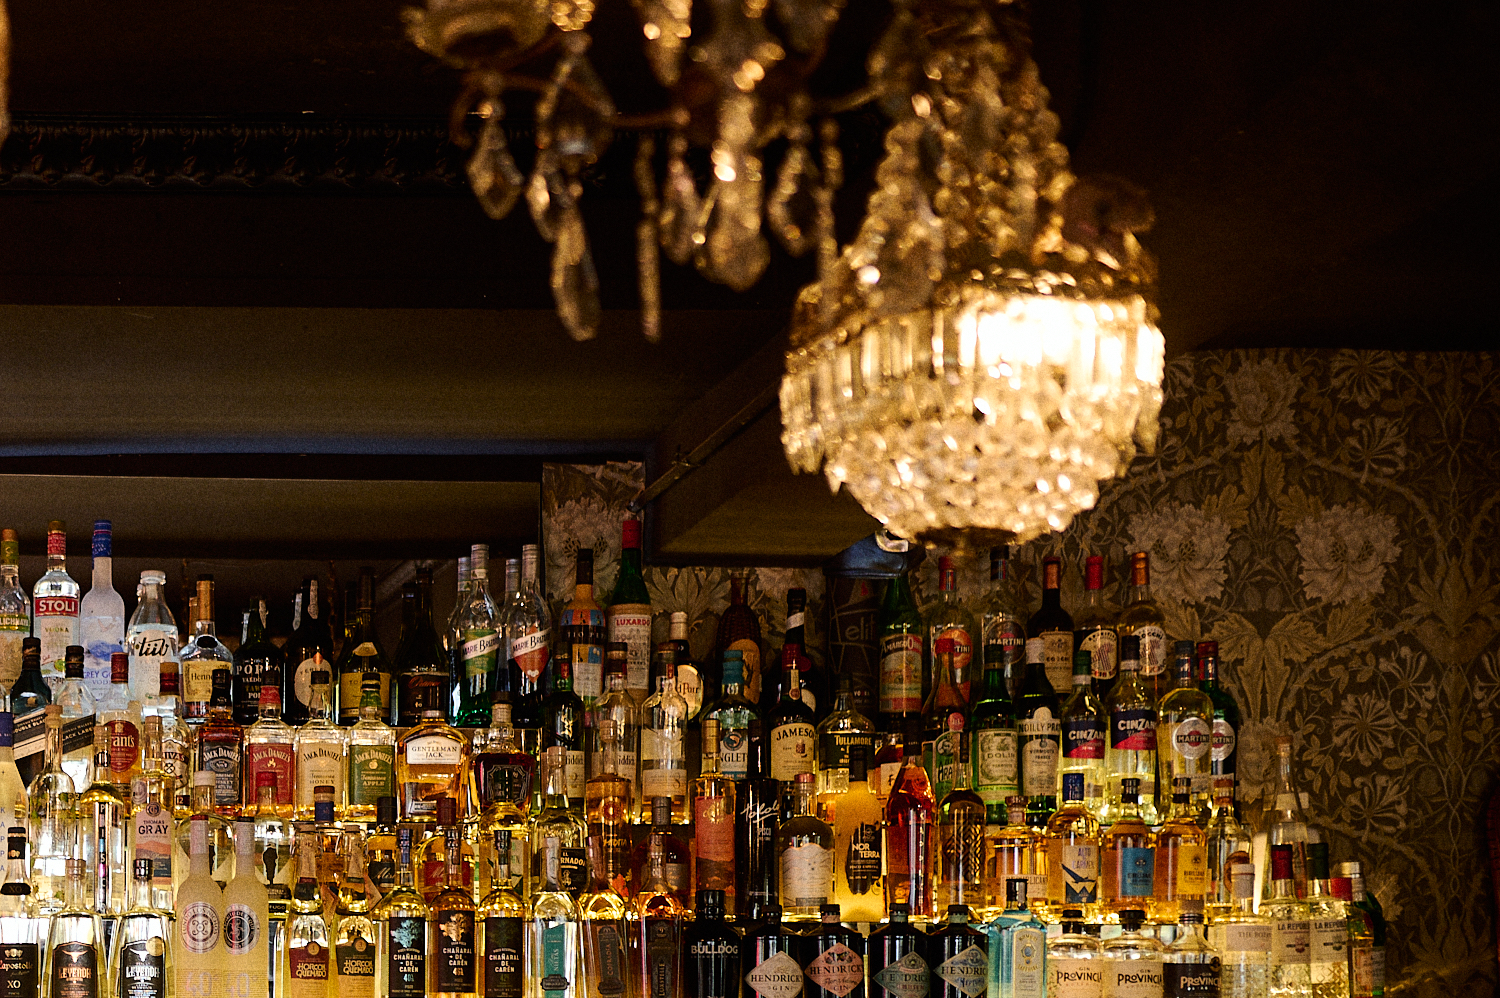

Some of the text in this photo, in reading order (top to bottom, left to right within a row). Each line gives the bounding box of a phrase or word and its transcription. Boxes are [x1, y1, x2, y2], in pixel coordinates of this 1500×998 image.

[39, 600, 75, 612] STOLI
[989, 637, 1024, 647] MARTINI
[954, 645, 971, 653] TINI
[191, 673, 213, 681] Henn
[1117, 718, 1156, 732] CINZAN
[1068, 729, 1106, 741] CINZAN
[1177, 735, 1210, 744] MARTINI
[834, 735, 872, 746] TULLAMORE
[203, 749, 217, 762] JACK
[253, 749, 267, 762] JACK
[303, 750, 318, 762] JACK
[355, 752, 370, 763] JACK
[138, 825, 168, 836] GRAY
[852, 843, 870, 851] NOR
[859, 851, 881, 859] TERRA
[1278, 922, 1286, 931] LA
[1314, 922, 1322, 930] LA
[442, 946, 472, 955] CHAÑARAL
[690, 944, 739, 955] BULLDOG
[393, 952, 423, 961] CHAÑARAL
[489, 952, 520, 961] CHAÑARAL
[399, 965, 419, 973] CARÉN
[495, 965, 515, 973] CARÉN
[941, 967, 987, 975] HENDRIC
[750, 974, 803, 983] HENDRICK
[7, 980, 21, 989] XO
